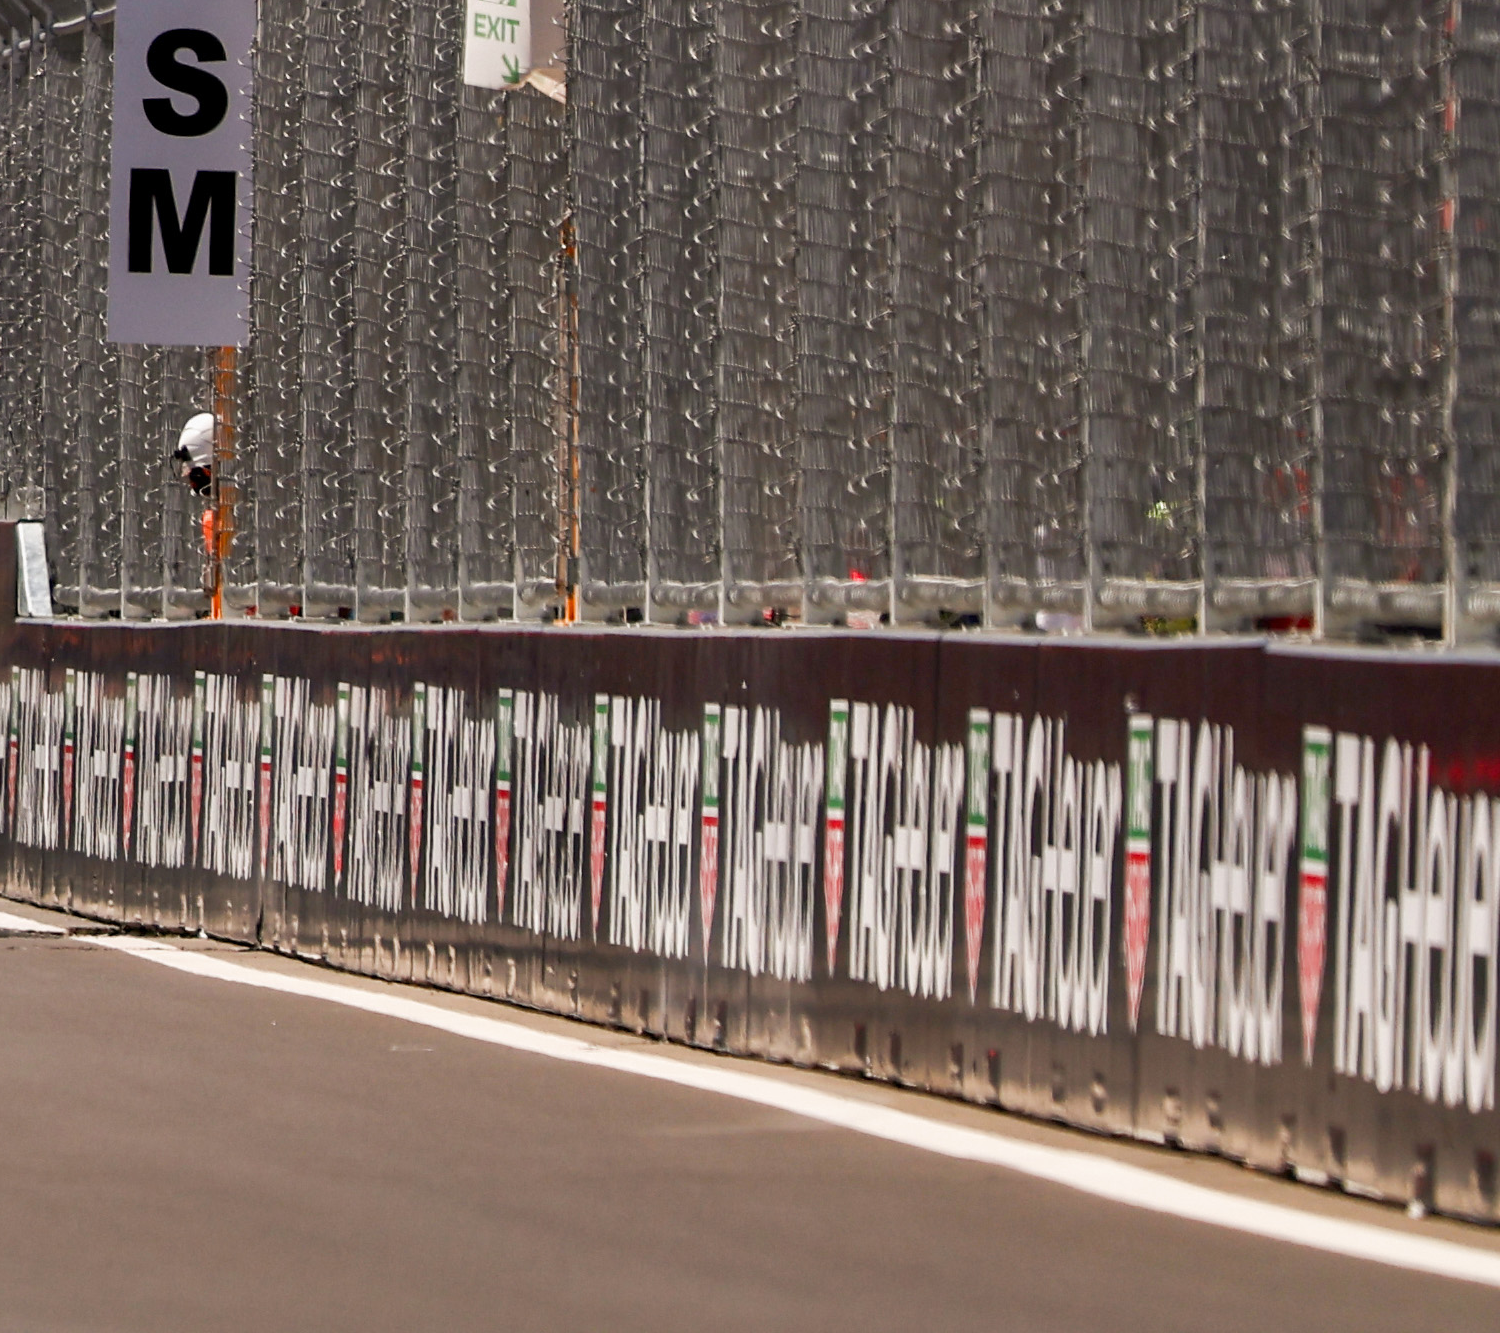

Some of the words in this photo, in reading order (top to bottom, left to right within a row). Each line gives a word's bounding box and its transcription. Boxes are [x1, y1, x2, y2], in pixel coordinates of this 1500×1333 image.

[142, 28, 228, 137] S
[474, 14, 520, 44] EXIT
[127, 168, 238, 276] M
